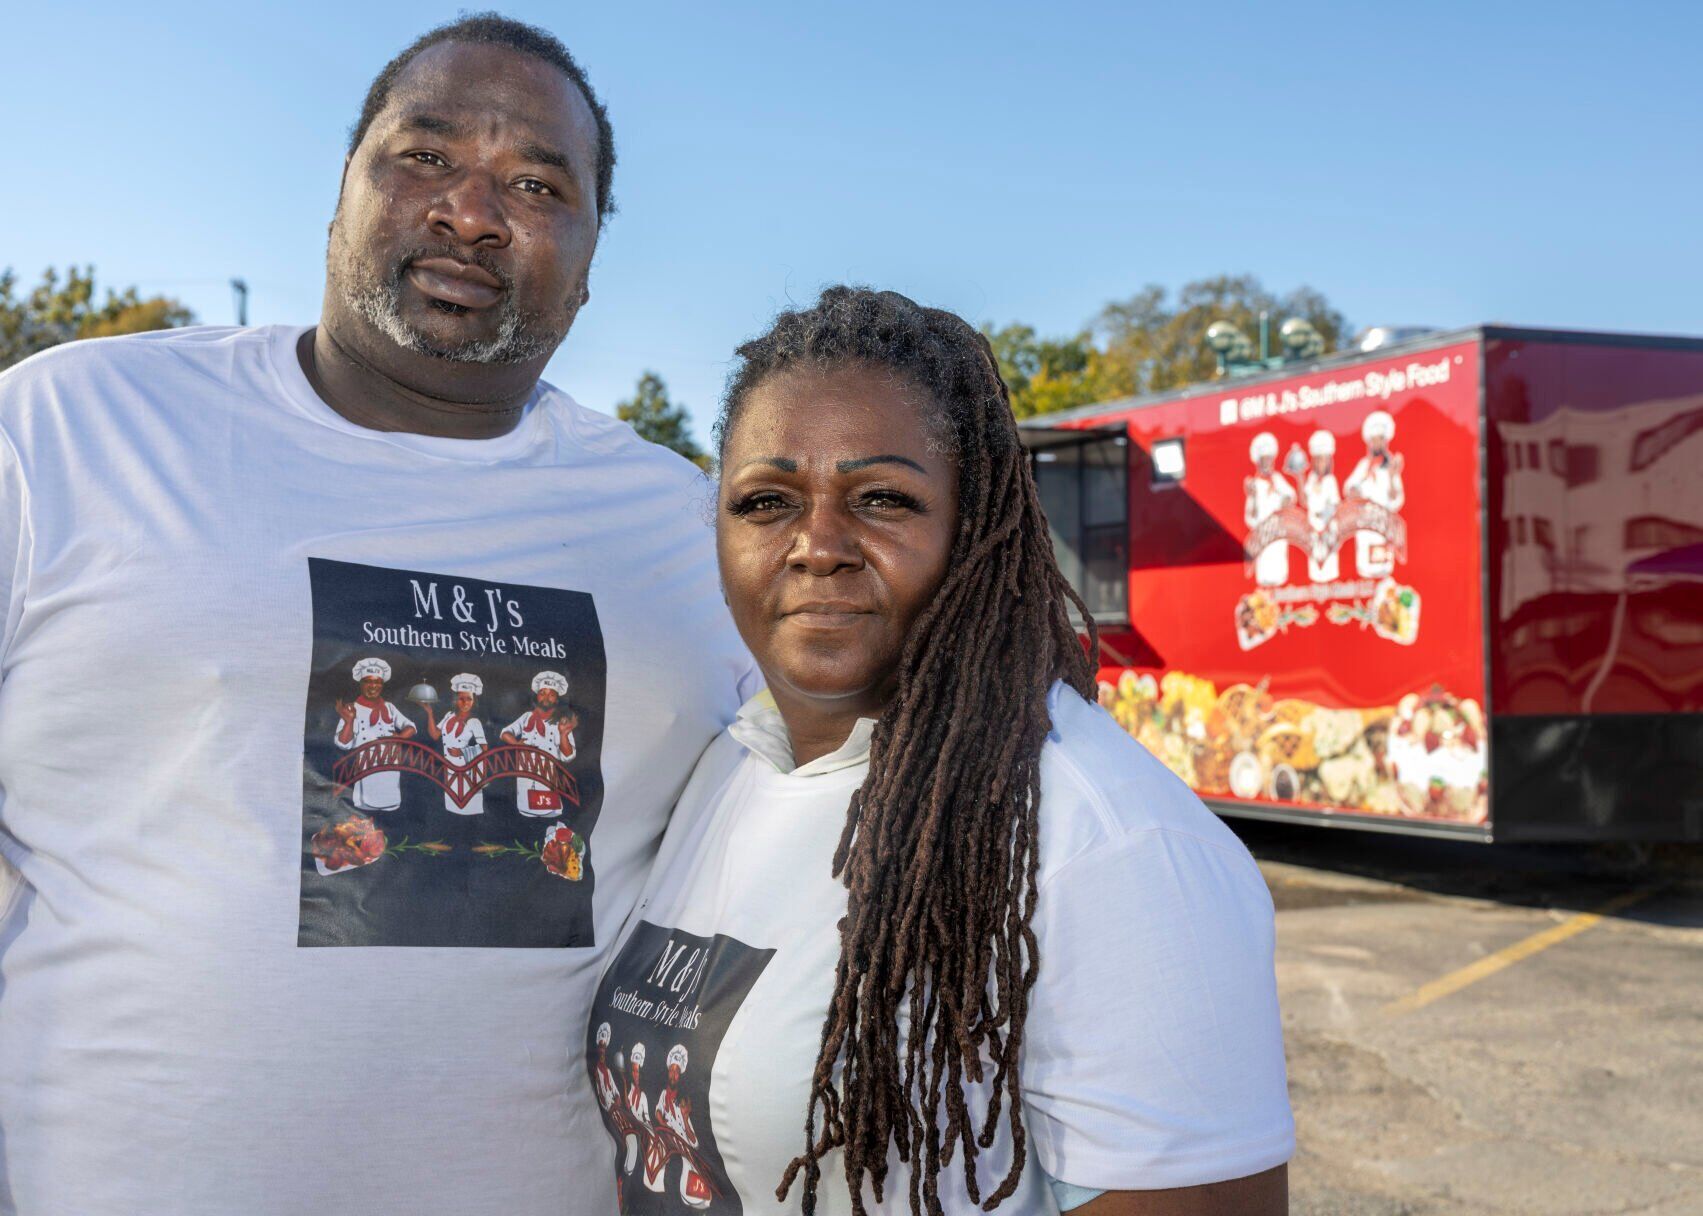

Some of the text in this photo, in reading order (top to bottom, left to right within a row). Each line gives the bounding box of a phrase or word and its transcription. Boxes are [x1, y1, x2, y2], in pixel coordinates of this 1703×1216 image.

[1298, 379, 1364, 410] Southern
[1363, 368, 1406, 399] Style
[1405, 356, 1450, 389] Food
[410, 580, 524, 633] M & J's
[363, 621, 567, 659] Southern Style Meals
[536, 795, 552, 806] J's
[646, 940, 688, 988] M
[670, 947, 701, 993] &
[609, 986, 654, 1018] Southern
[649, 1000, 681, 1027] Style
